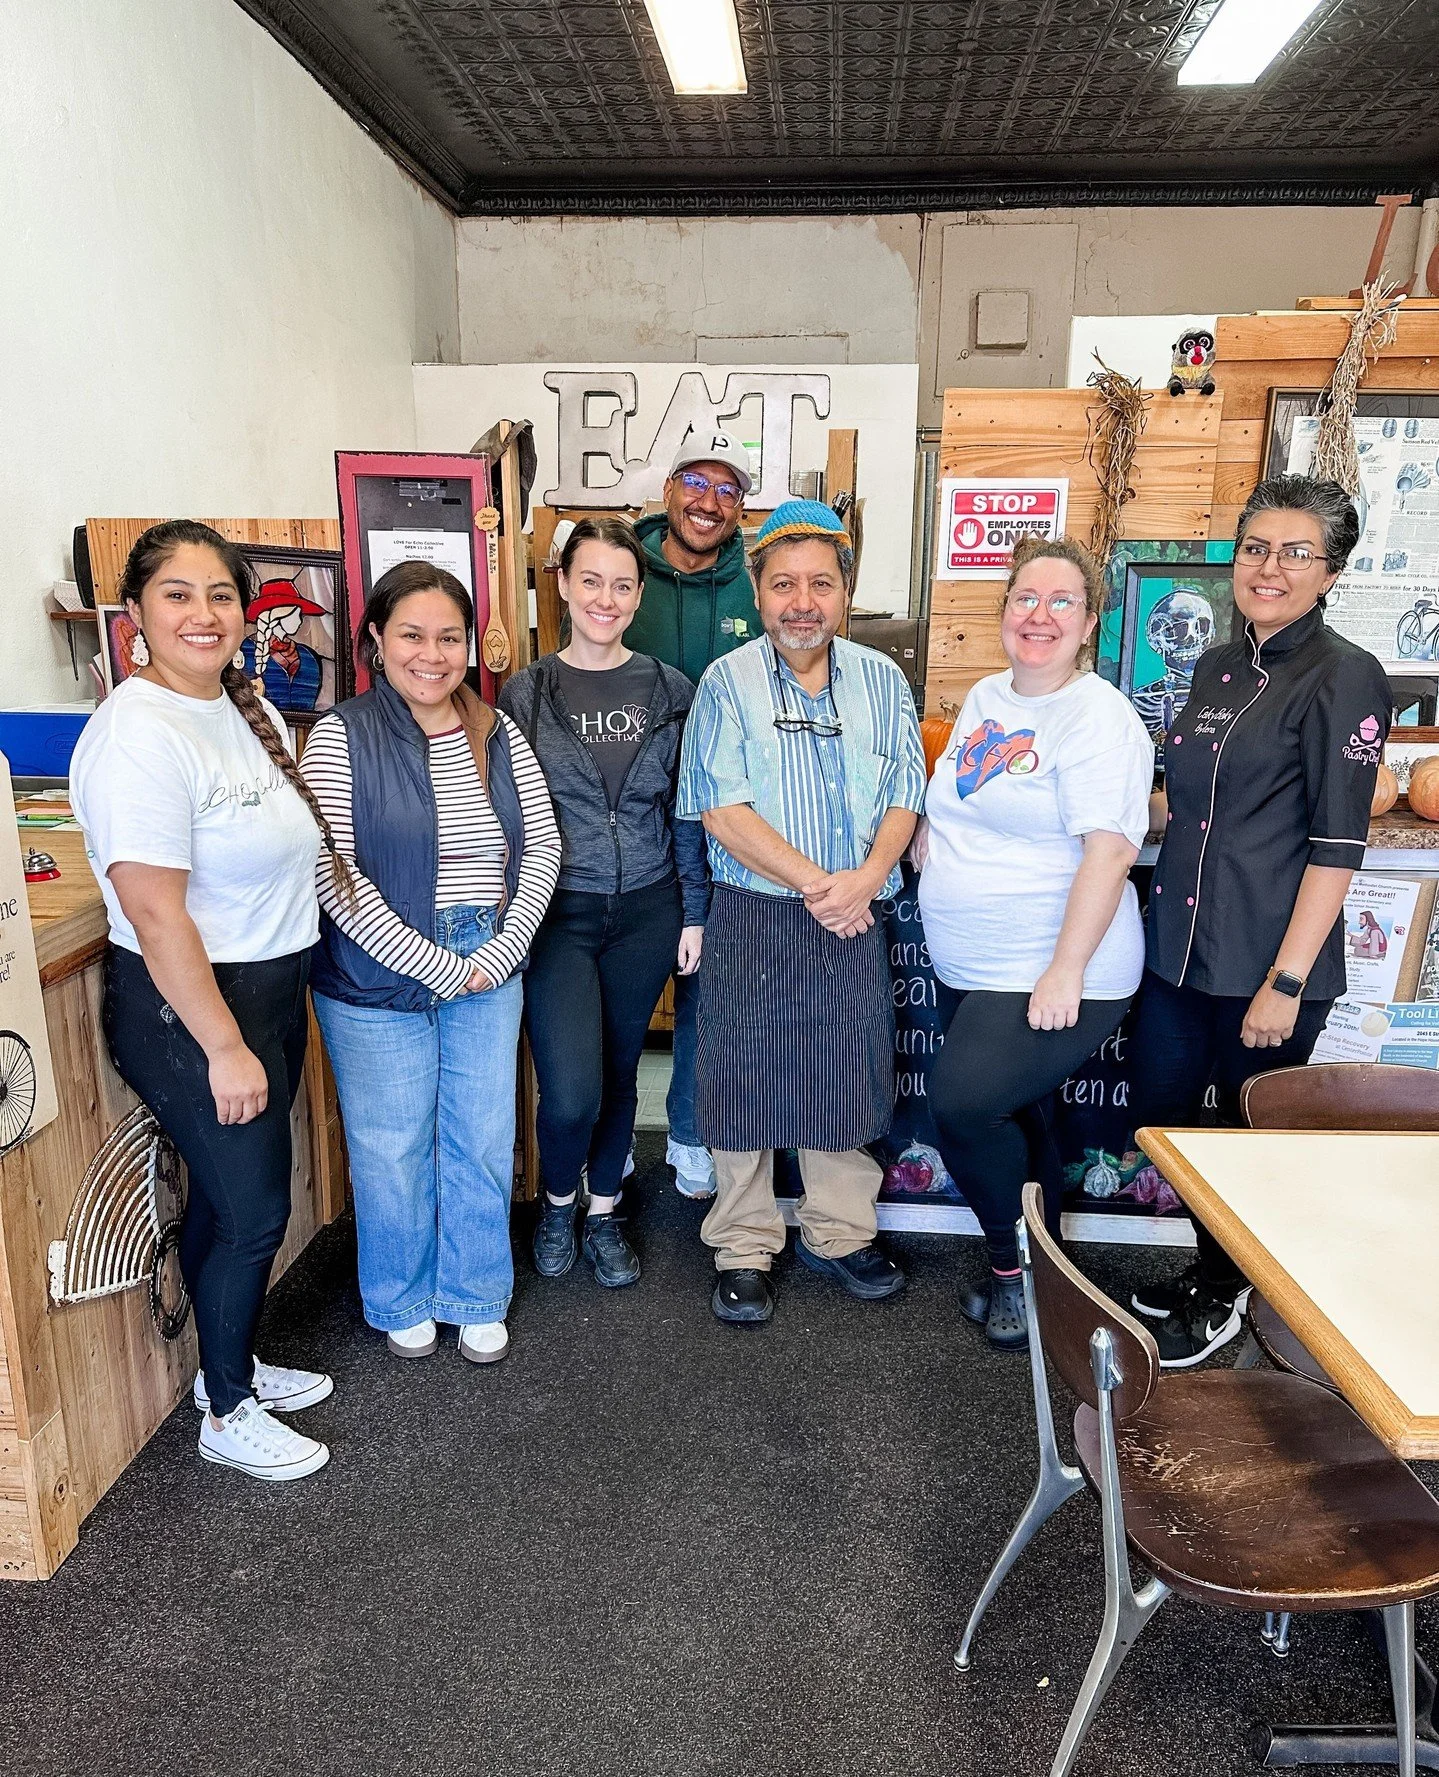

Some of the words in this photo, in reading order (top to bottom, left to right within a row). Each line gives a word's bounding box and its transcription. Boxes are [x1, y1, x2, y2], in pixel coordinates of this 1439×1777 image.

[1348, 194, 1439, 301] L
[543, 371, 830, 512] EAT
[972, 495, 1037, 512] STOP
[987, 521, 1051, 529] EMPLOYEES
[580, 733, 641, 743] OLLECTIVE
[1342, 746, 1369, 766] Pastry
[1368, 889, 1396, 899] Great!!
[5, 950, 16, 963] are
[1398, 1008, 1425, 1019] Tool
[1428, 1008, 1439, 1019] Li
[1090, 1026, 1128, 1062] rt
[1342, 1038, 1370, 1051] Recovery
